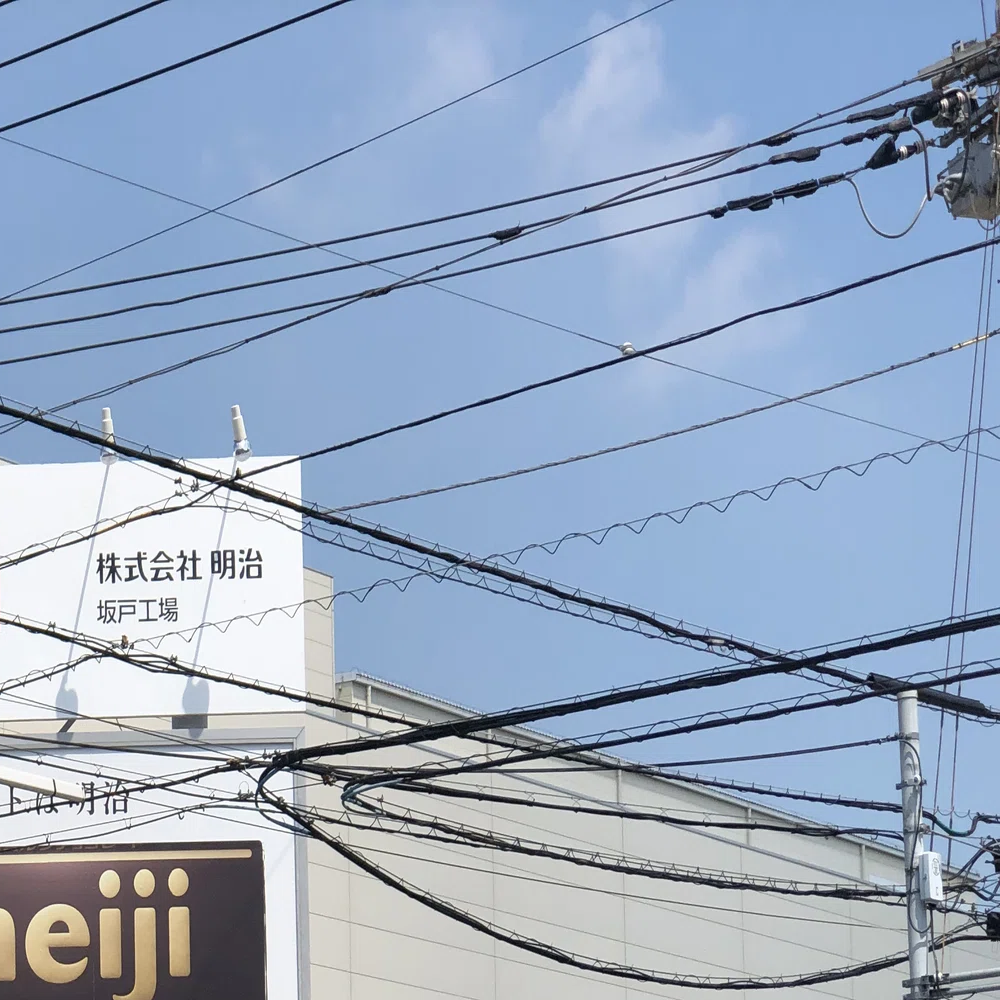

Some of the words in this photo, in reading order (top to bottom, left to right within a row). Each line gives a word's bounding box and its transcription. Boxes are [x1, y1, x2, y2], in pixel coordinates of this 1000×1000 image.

[96, 551, 202, 584] 株式会社
[211, 548, 263, 581] 明治
[96, 598, 179, 623] 坂戸工場
